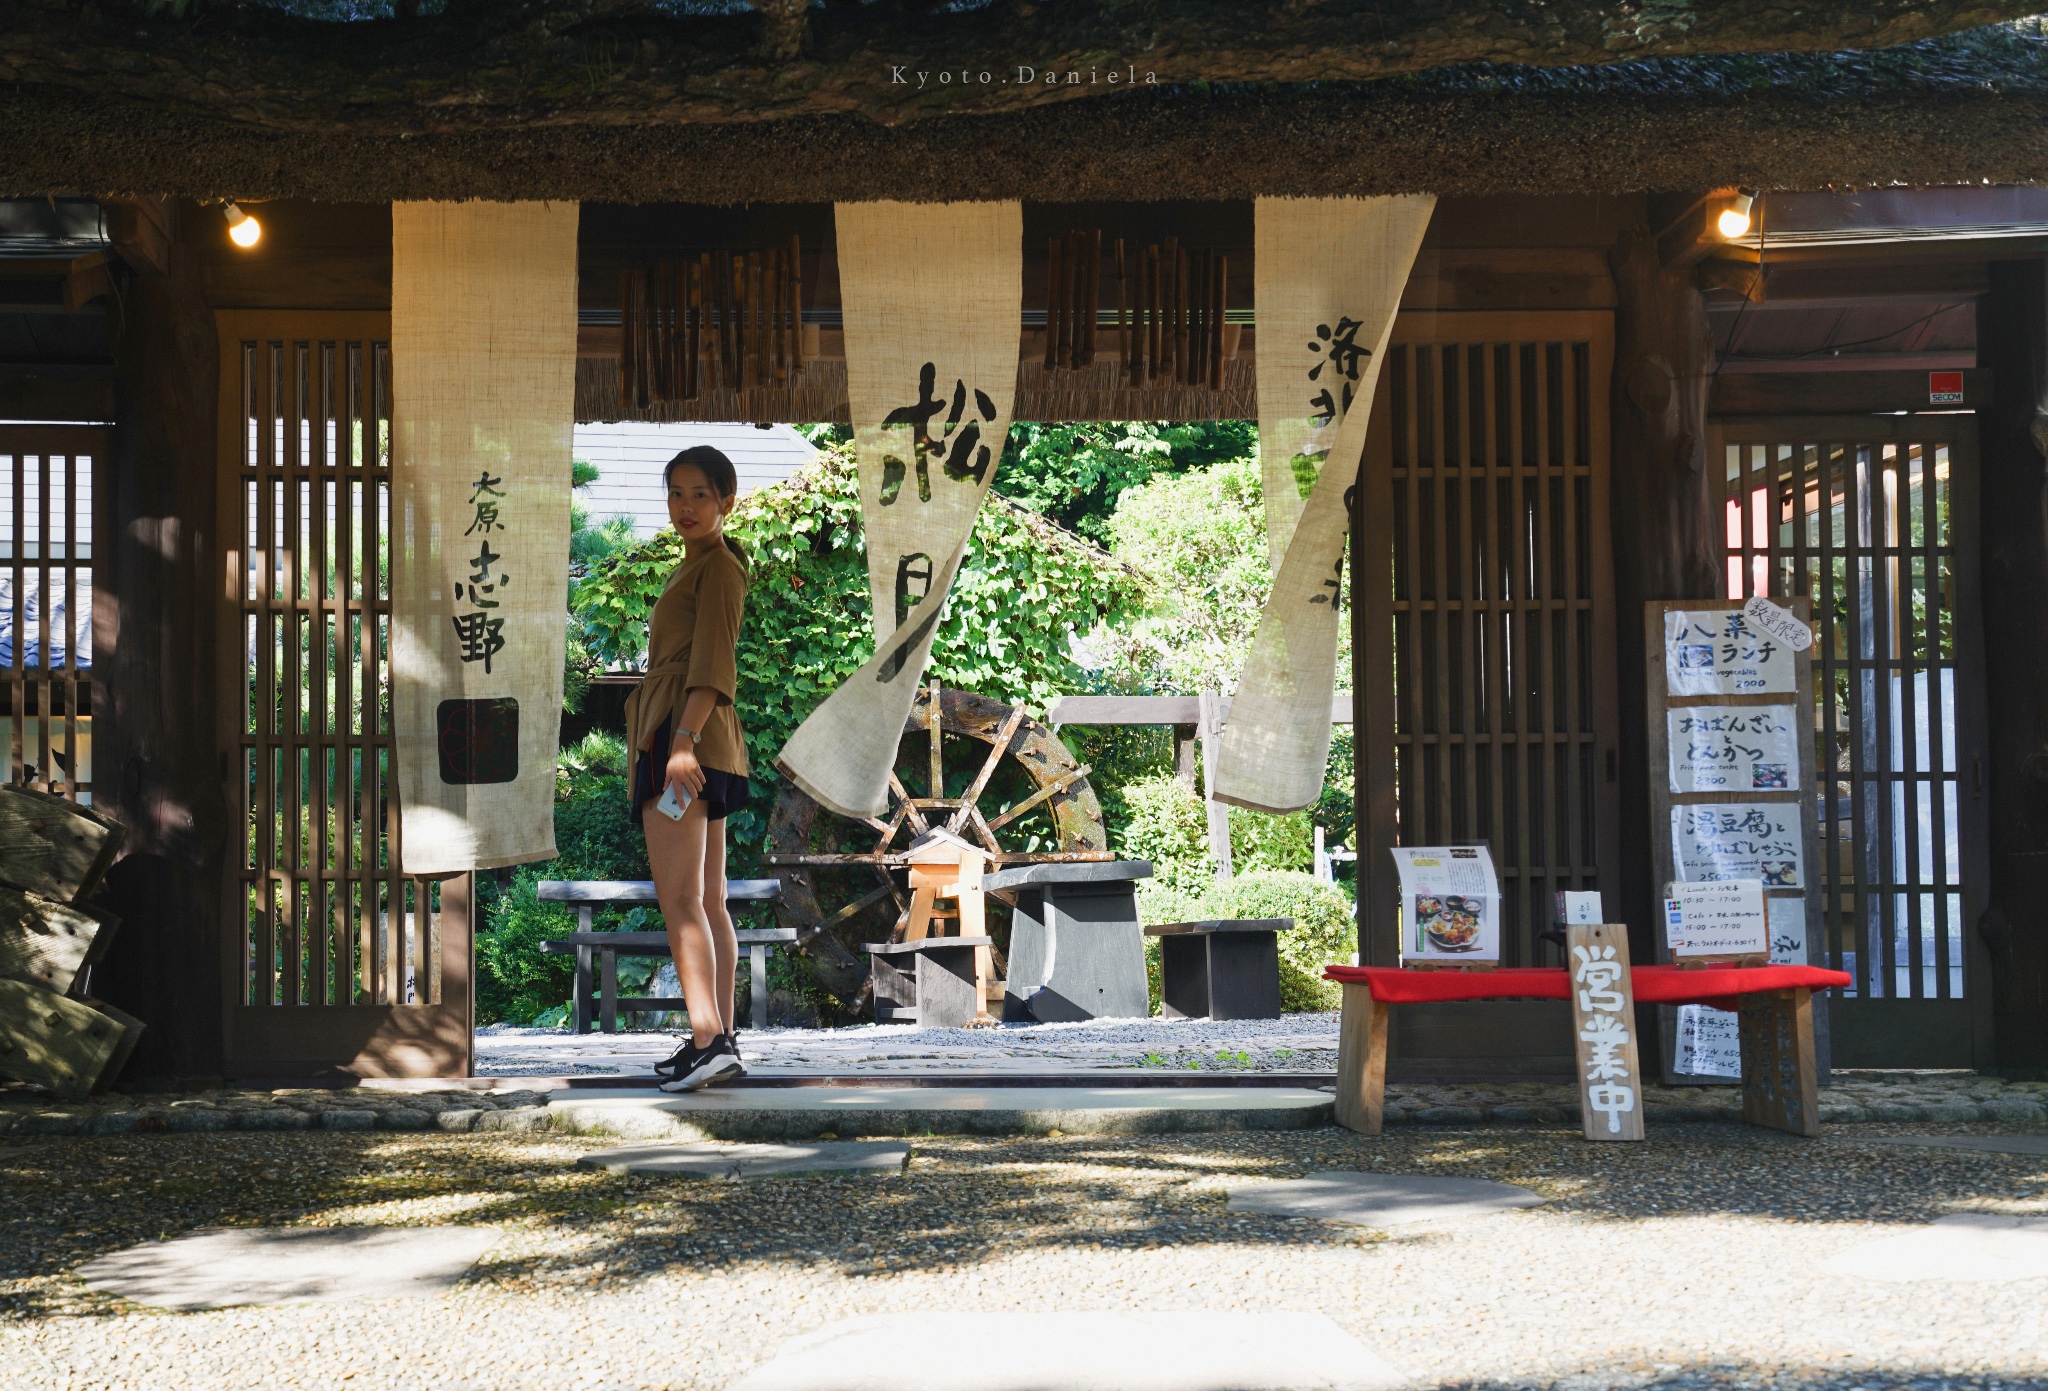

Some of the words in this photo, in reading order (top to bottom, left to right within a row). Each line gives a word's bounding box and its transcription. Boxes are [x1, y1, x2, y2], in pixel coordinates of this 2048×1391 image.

[1932, 393, 1961, 401] SECOM
[453, 471, 509, 675] 大原志野
[1676, 613, 1757, 641] 八菜
[1749, 600, 1805, 647] 数量限定
[1721, 641, 1776, 663] ランチ
[1735, 679, 1766, 688] 2000
[1687, 742, 1764, 762] とんかつ
[1695, 776, 1726, 785] 2300
[1700, 872, 1731, 881] 2500
[1573, 945, 1635, 1133] 営業中
